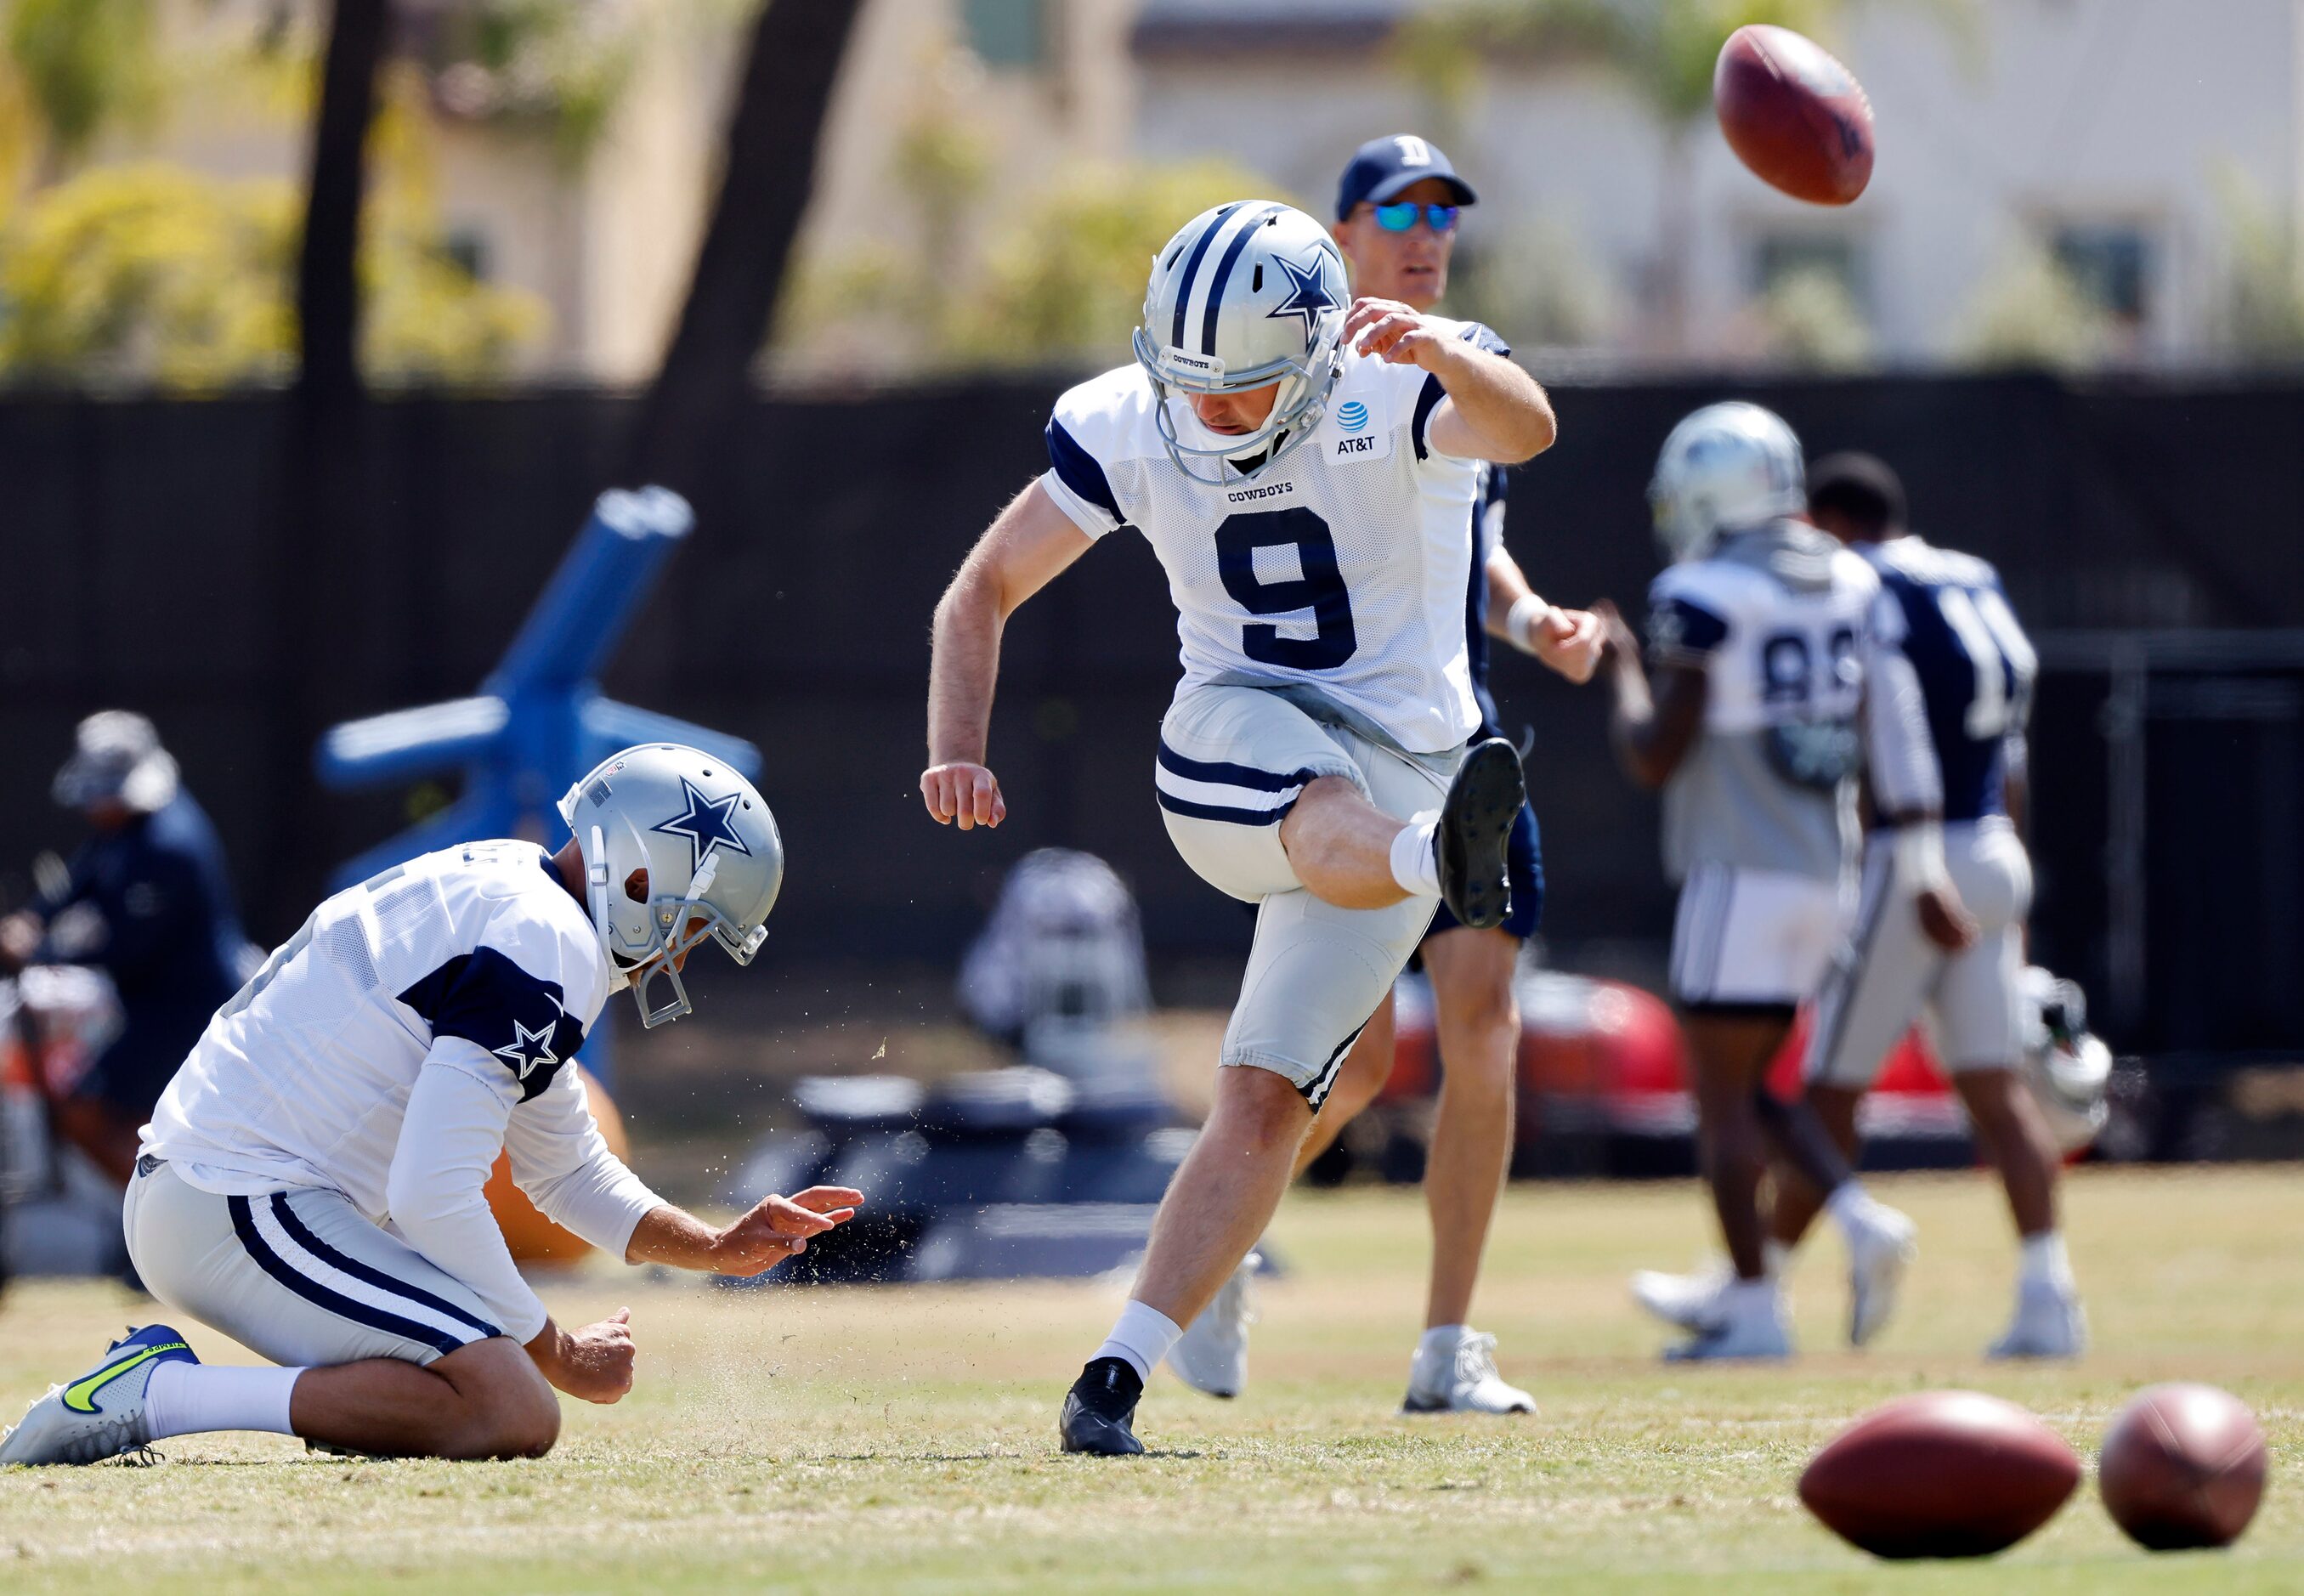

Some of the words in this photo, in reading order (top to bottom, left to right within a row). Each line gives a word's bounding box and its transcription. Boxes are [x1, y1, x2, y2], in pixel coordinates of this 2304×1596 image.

[1394, 135, 1431, 166] D
[1174, 354, 1209, 369] COWBOYS
[1338, 436, 1375, 455] AT&T
[1228, 482, 1293, 502] COWBOYS
[1214, 507, 1357, 671] 9
